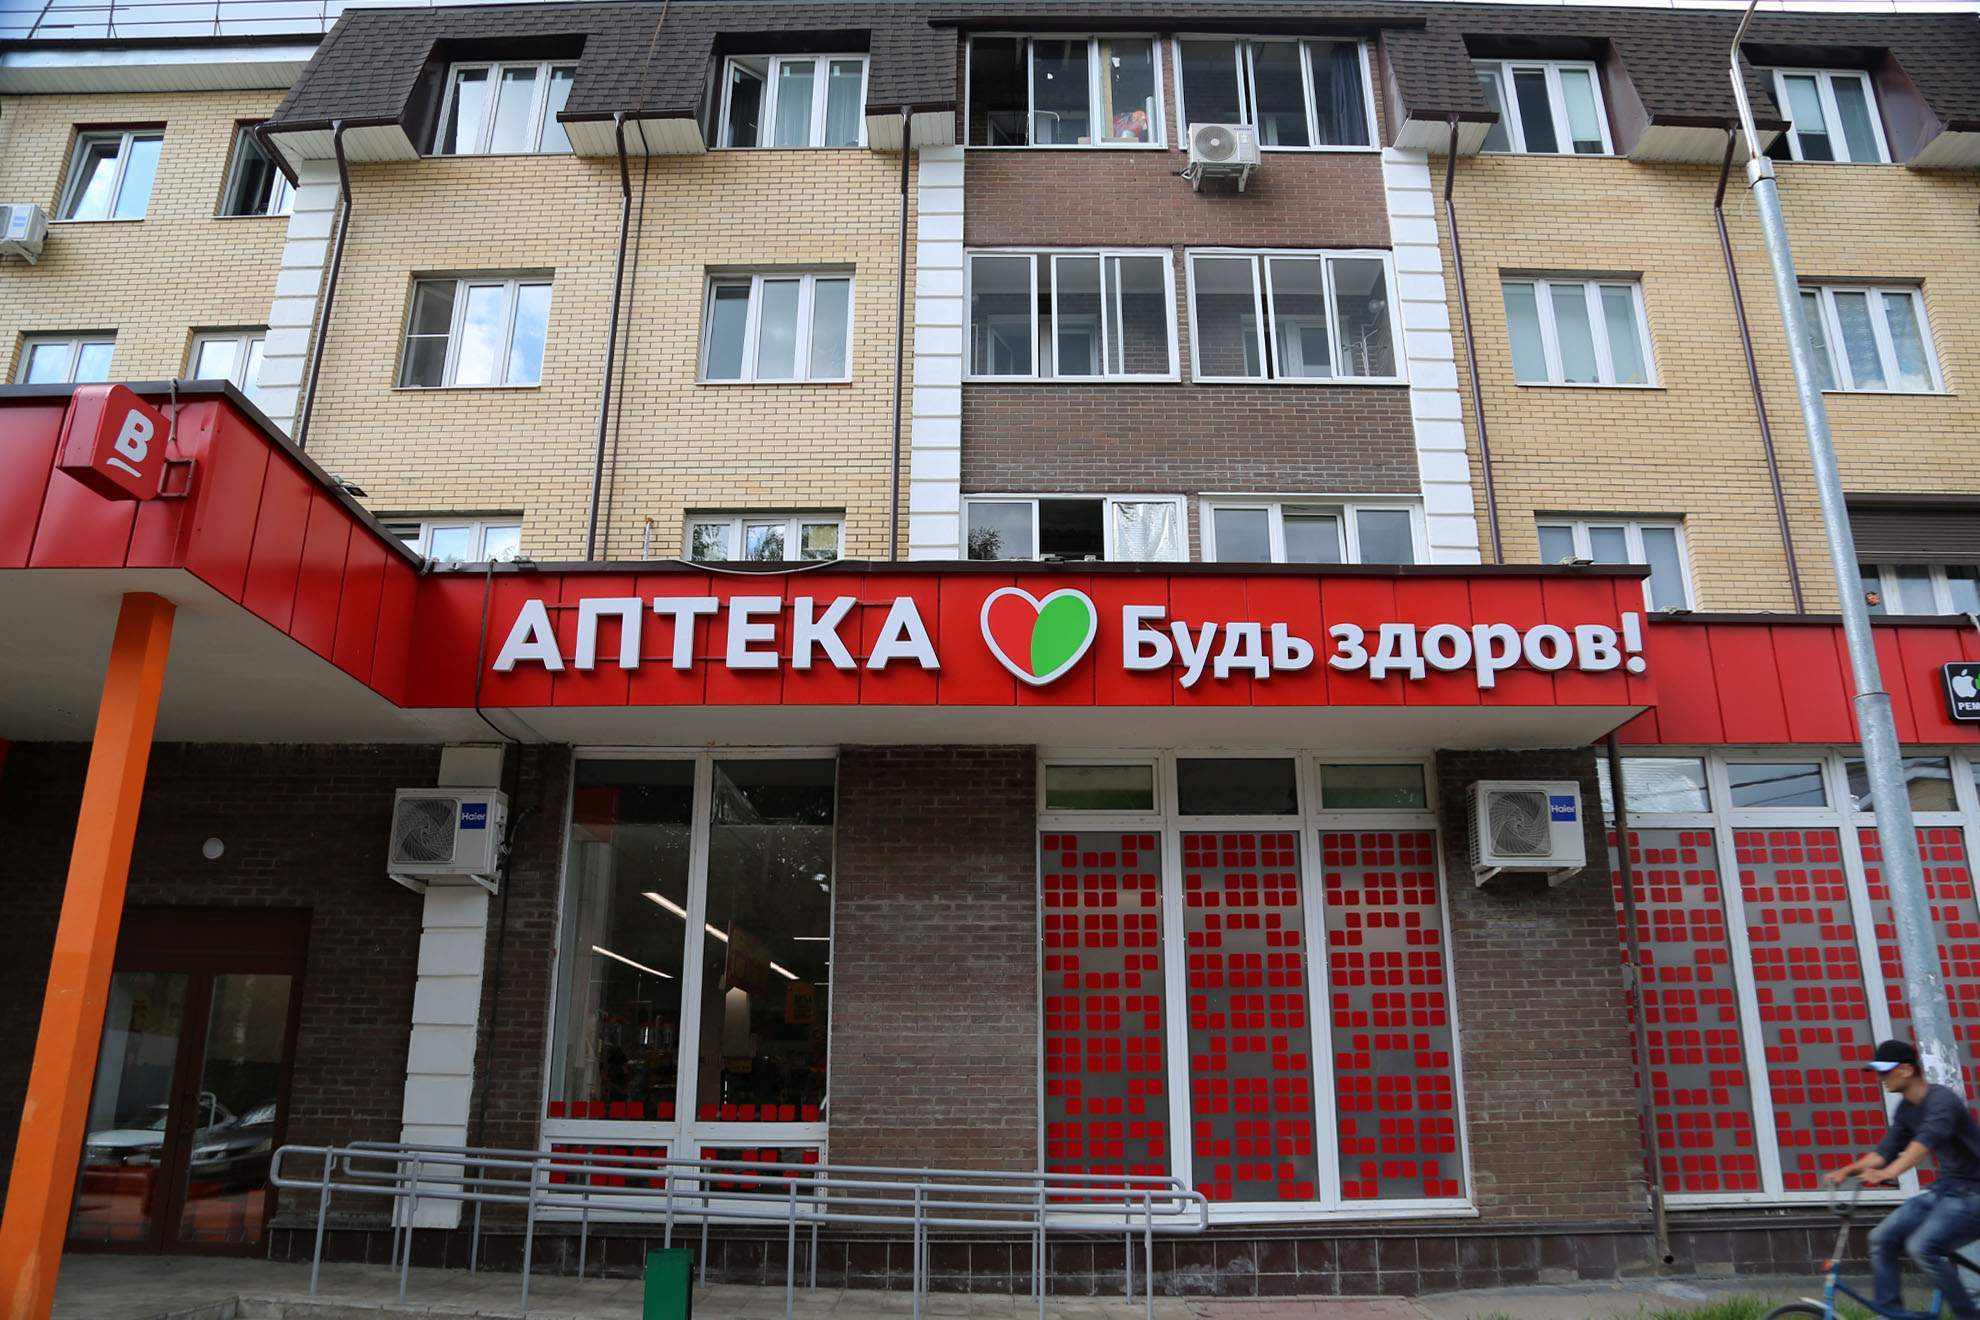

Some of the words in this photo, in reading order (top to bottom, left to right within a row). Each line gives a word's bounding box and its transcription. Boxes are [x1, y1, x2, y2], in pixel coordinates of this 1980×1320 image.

[492, 595, 941, 672] АПТЕКА
[1121, 604, 1315, 689] Будь
[1328, 611, 1647, 689] здоров!
[1551, 804, 1576, 813] Haier
[461, 812, 486, 821] Haier
